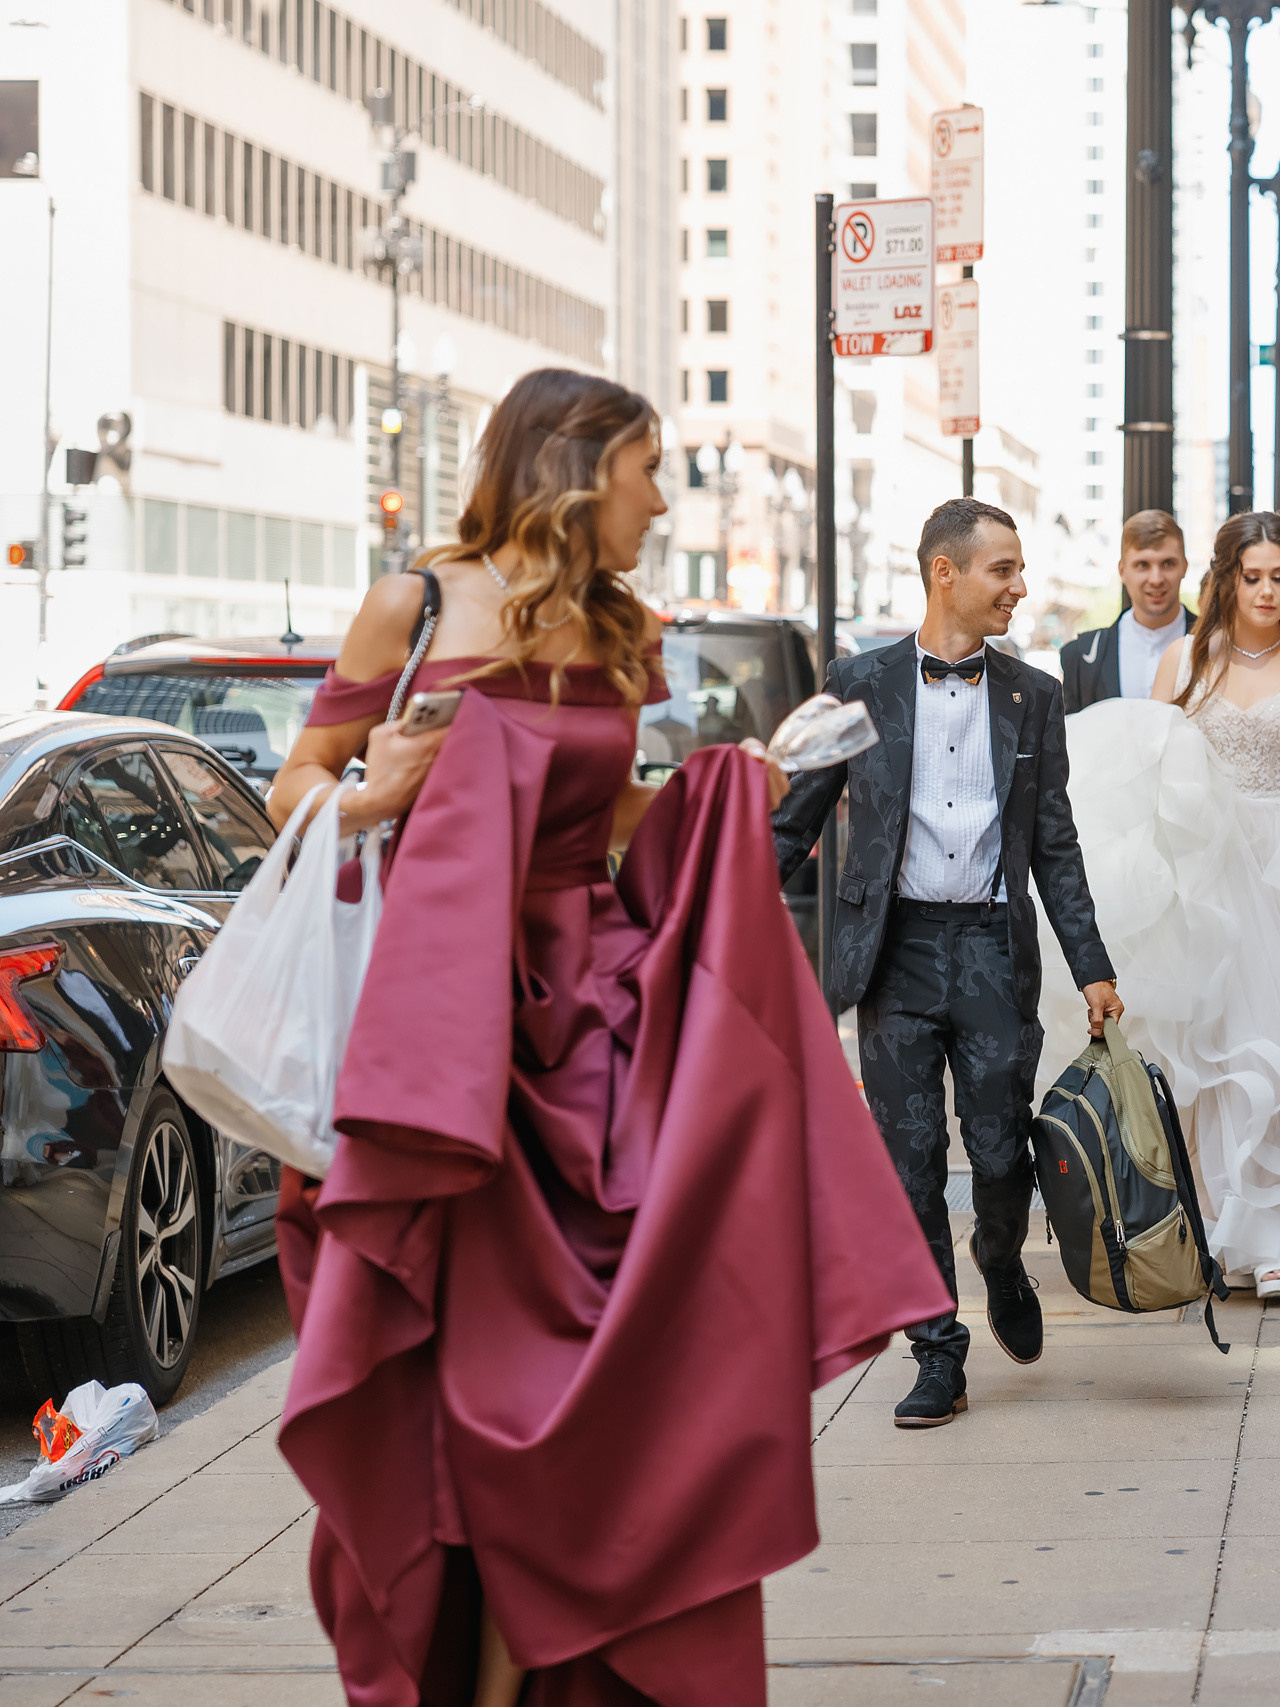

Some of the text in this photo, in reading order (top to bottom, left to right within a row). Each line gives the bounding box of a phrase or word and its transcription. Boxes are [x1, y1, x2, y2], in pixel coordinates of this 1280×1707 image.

[886, 237, 924, 254] $71.00
[842, 272, 923, 291] VALET LOADING
[894, 304, 922, 319] LAZ
[839, 333, 875, 355] TOW
